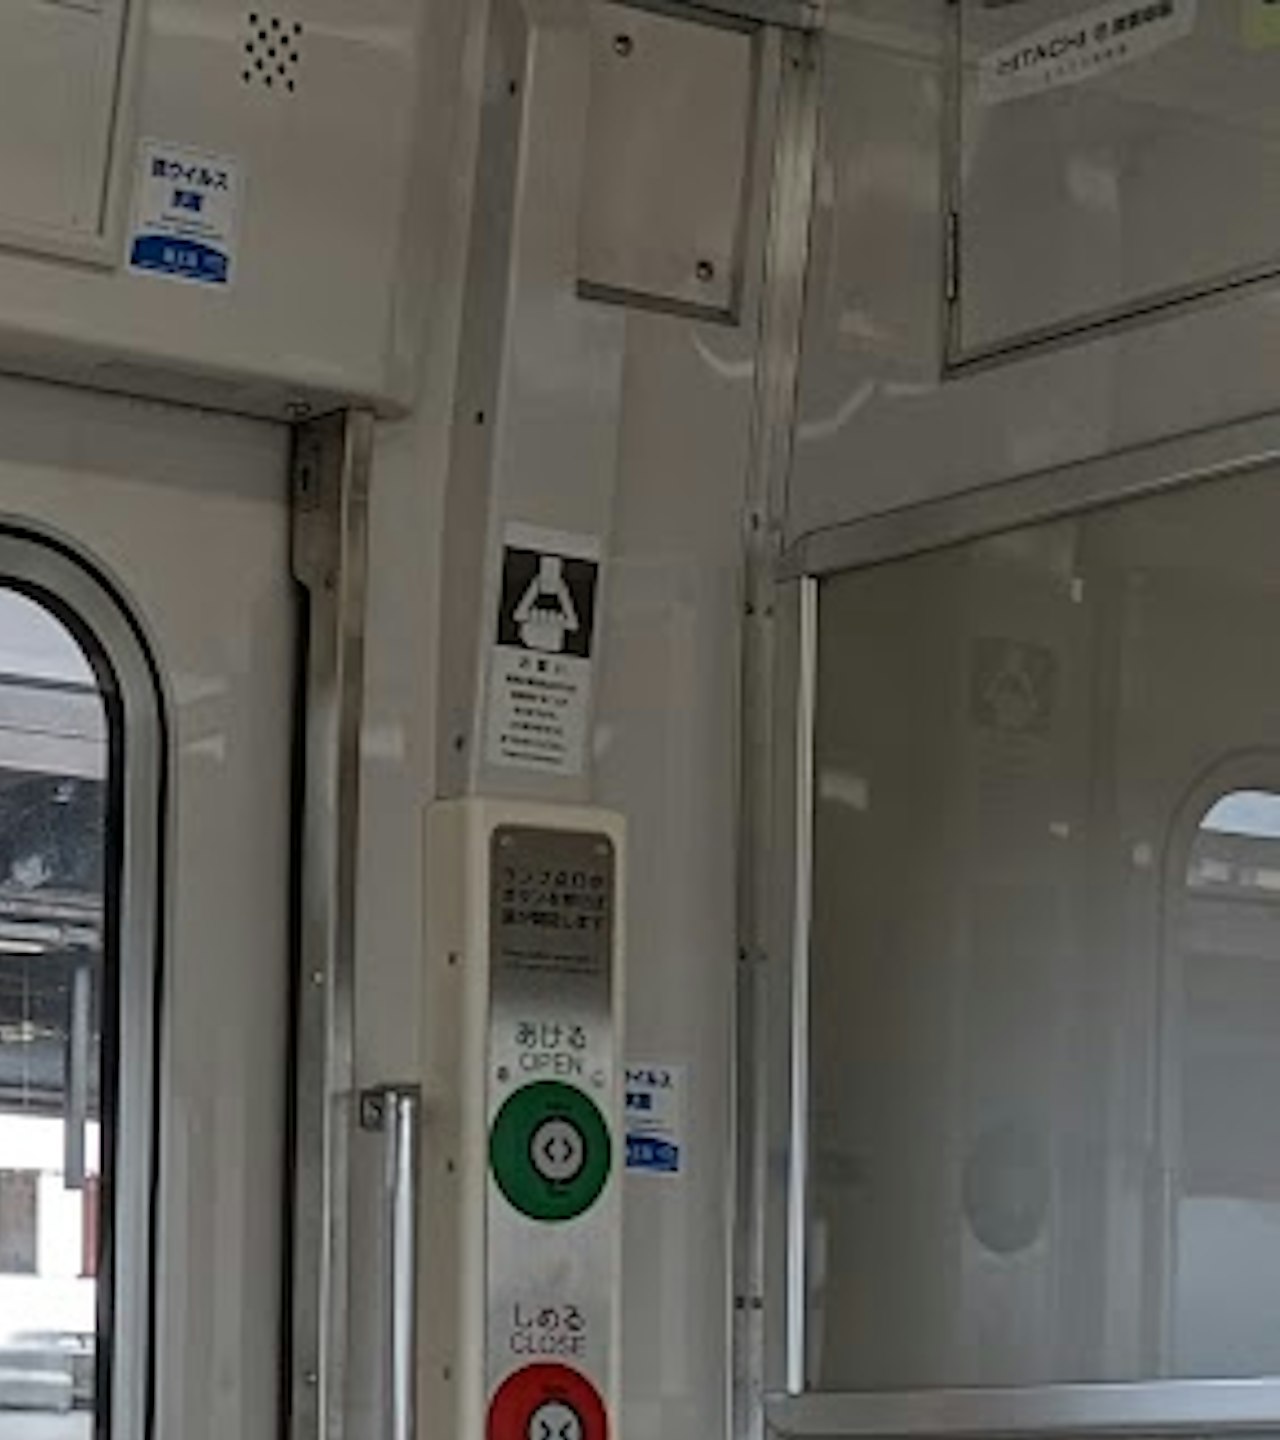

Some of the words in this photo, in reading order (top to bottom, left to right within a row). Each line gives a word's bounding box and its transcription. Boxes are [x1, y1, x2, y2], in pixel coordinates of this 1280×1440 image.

[996, 29, 1087, 77] HITACHI
[515, 1021, 587, 1049] あける
[518, 1052, 584, 1076] OPEN
[514, 1302, 587, 1331] しめる
[509, 1331, 587, 1357] CLOSE
